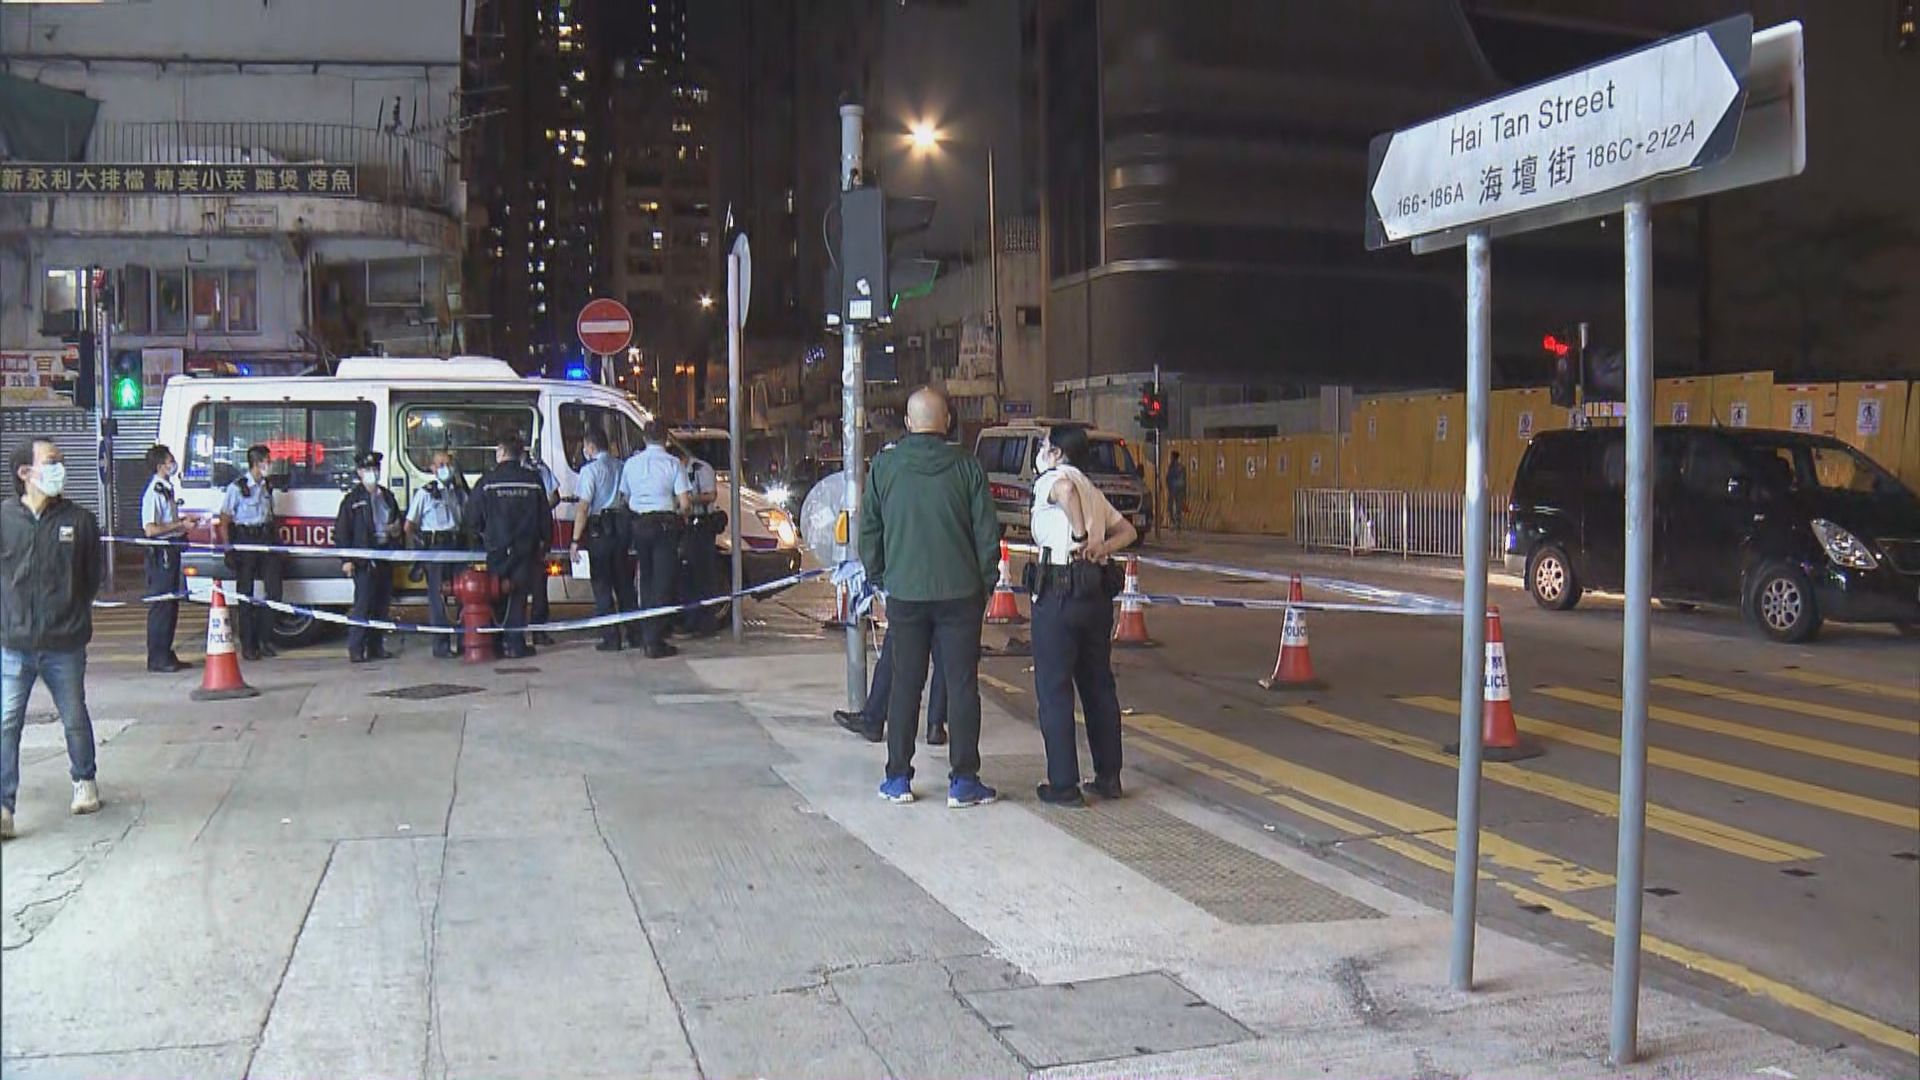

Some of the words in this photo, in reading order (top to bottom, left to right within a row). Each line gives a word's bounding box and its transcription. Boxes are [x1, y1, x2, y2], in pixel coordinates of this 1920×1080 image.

[1451, 121, 1483, 156] Hai
[1491, 112, 1529, 143] Tan
[1538, 80, 1616, 129] Street
[154, 168, 247, 191] 精美小菜
[308, 168, 352, 191] 烤魚
[1479, 146, 1576, 206] 海壇街
[279, 525, 336, 545] OLICE
[1484, 674, 1508, 688] LICE
